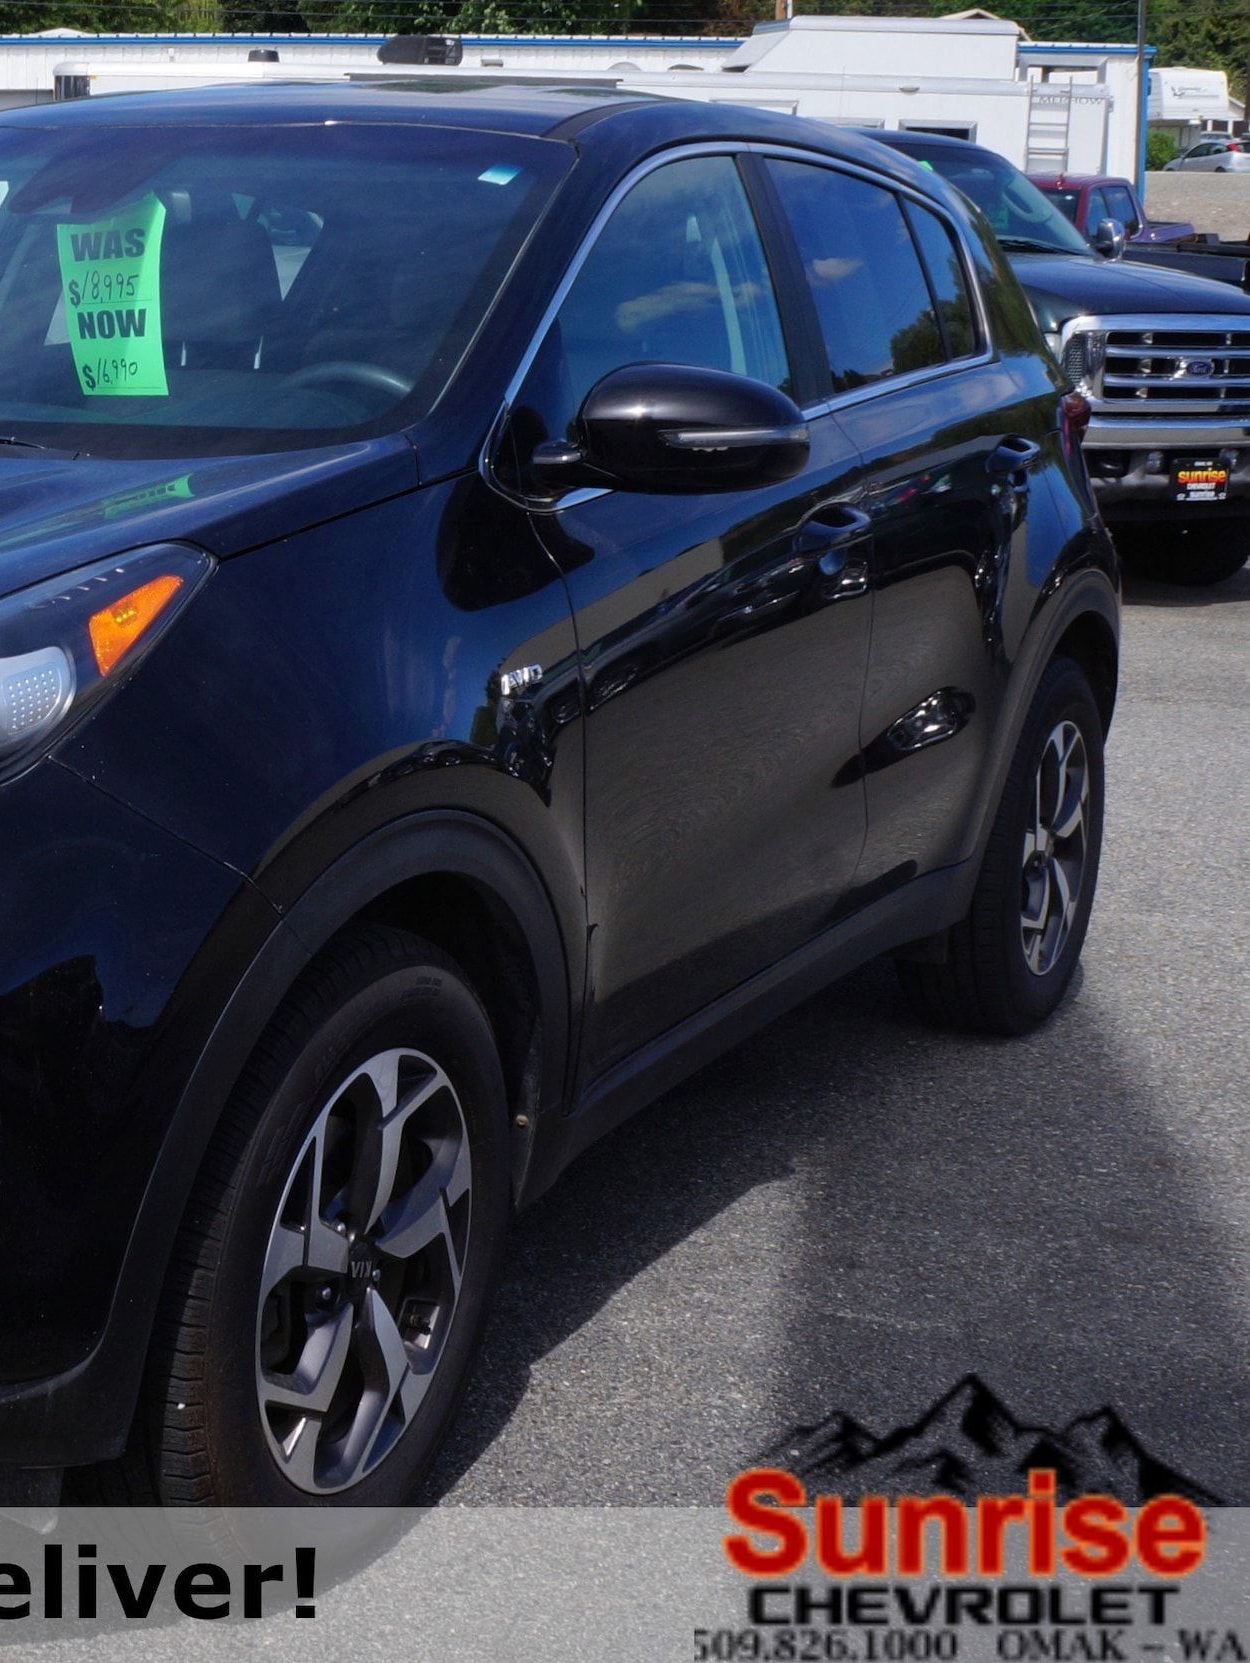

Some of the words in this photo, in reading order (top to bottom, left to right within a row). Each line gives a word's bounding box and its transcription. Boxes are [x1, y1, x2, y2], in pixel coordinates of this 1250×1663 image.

[70, 227, 146, 262] WAS
[77, 308, 147, 340] NOW
[1177, 467, 1227, 484] sunrise
